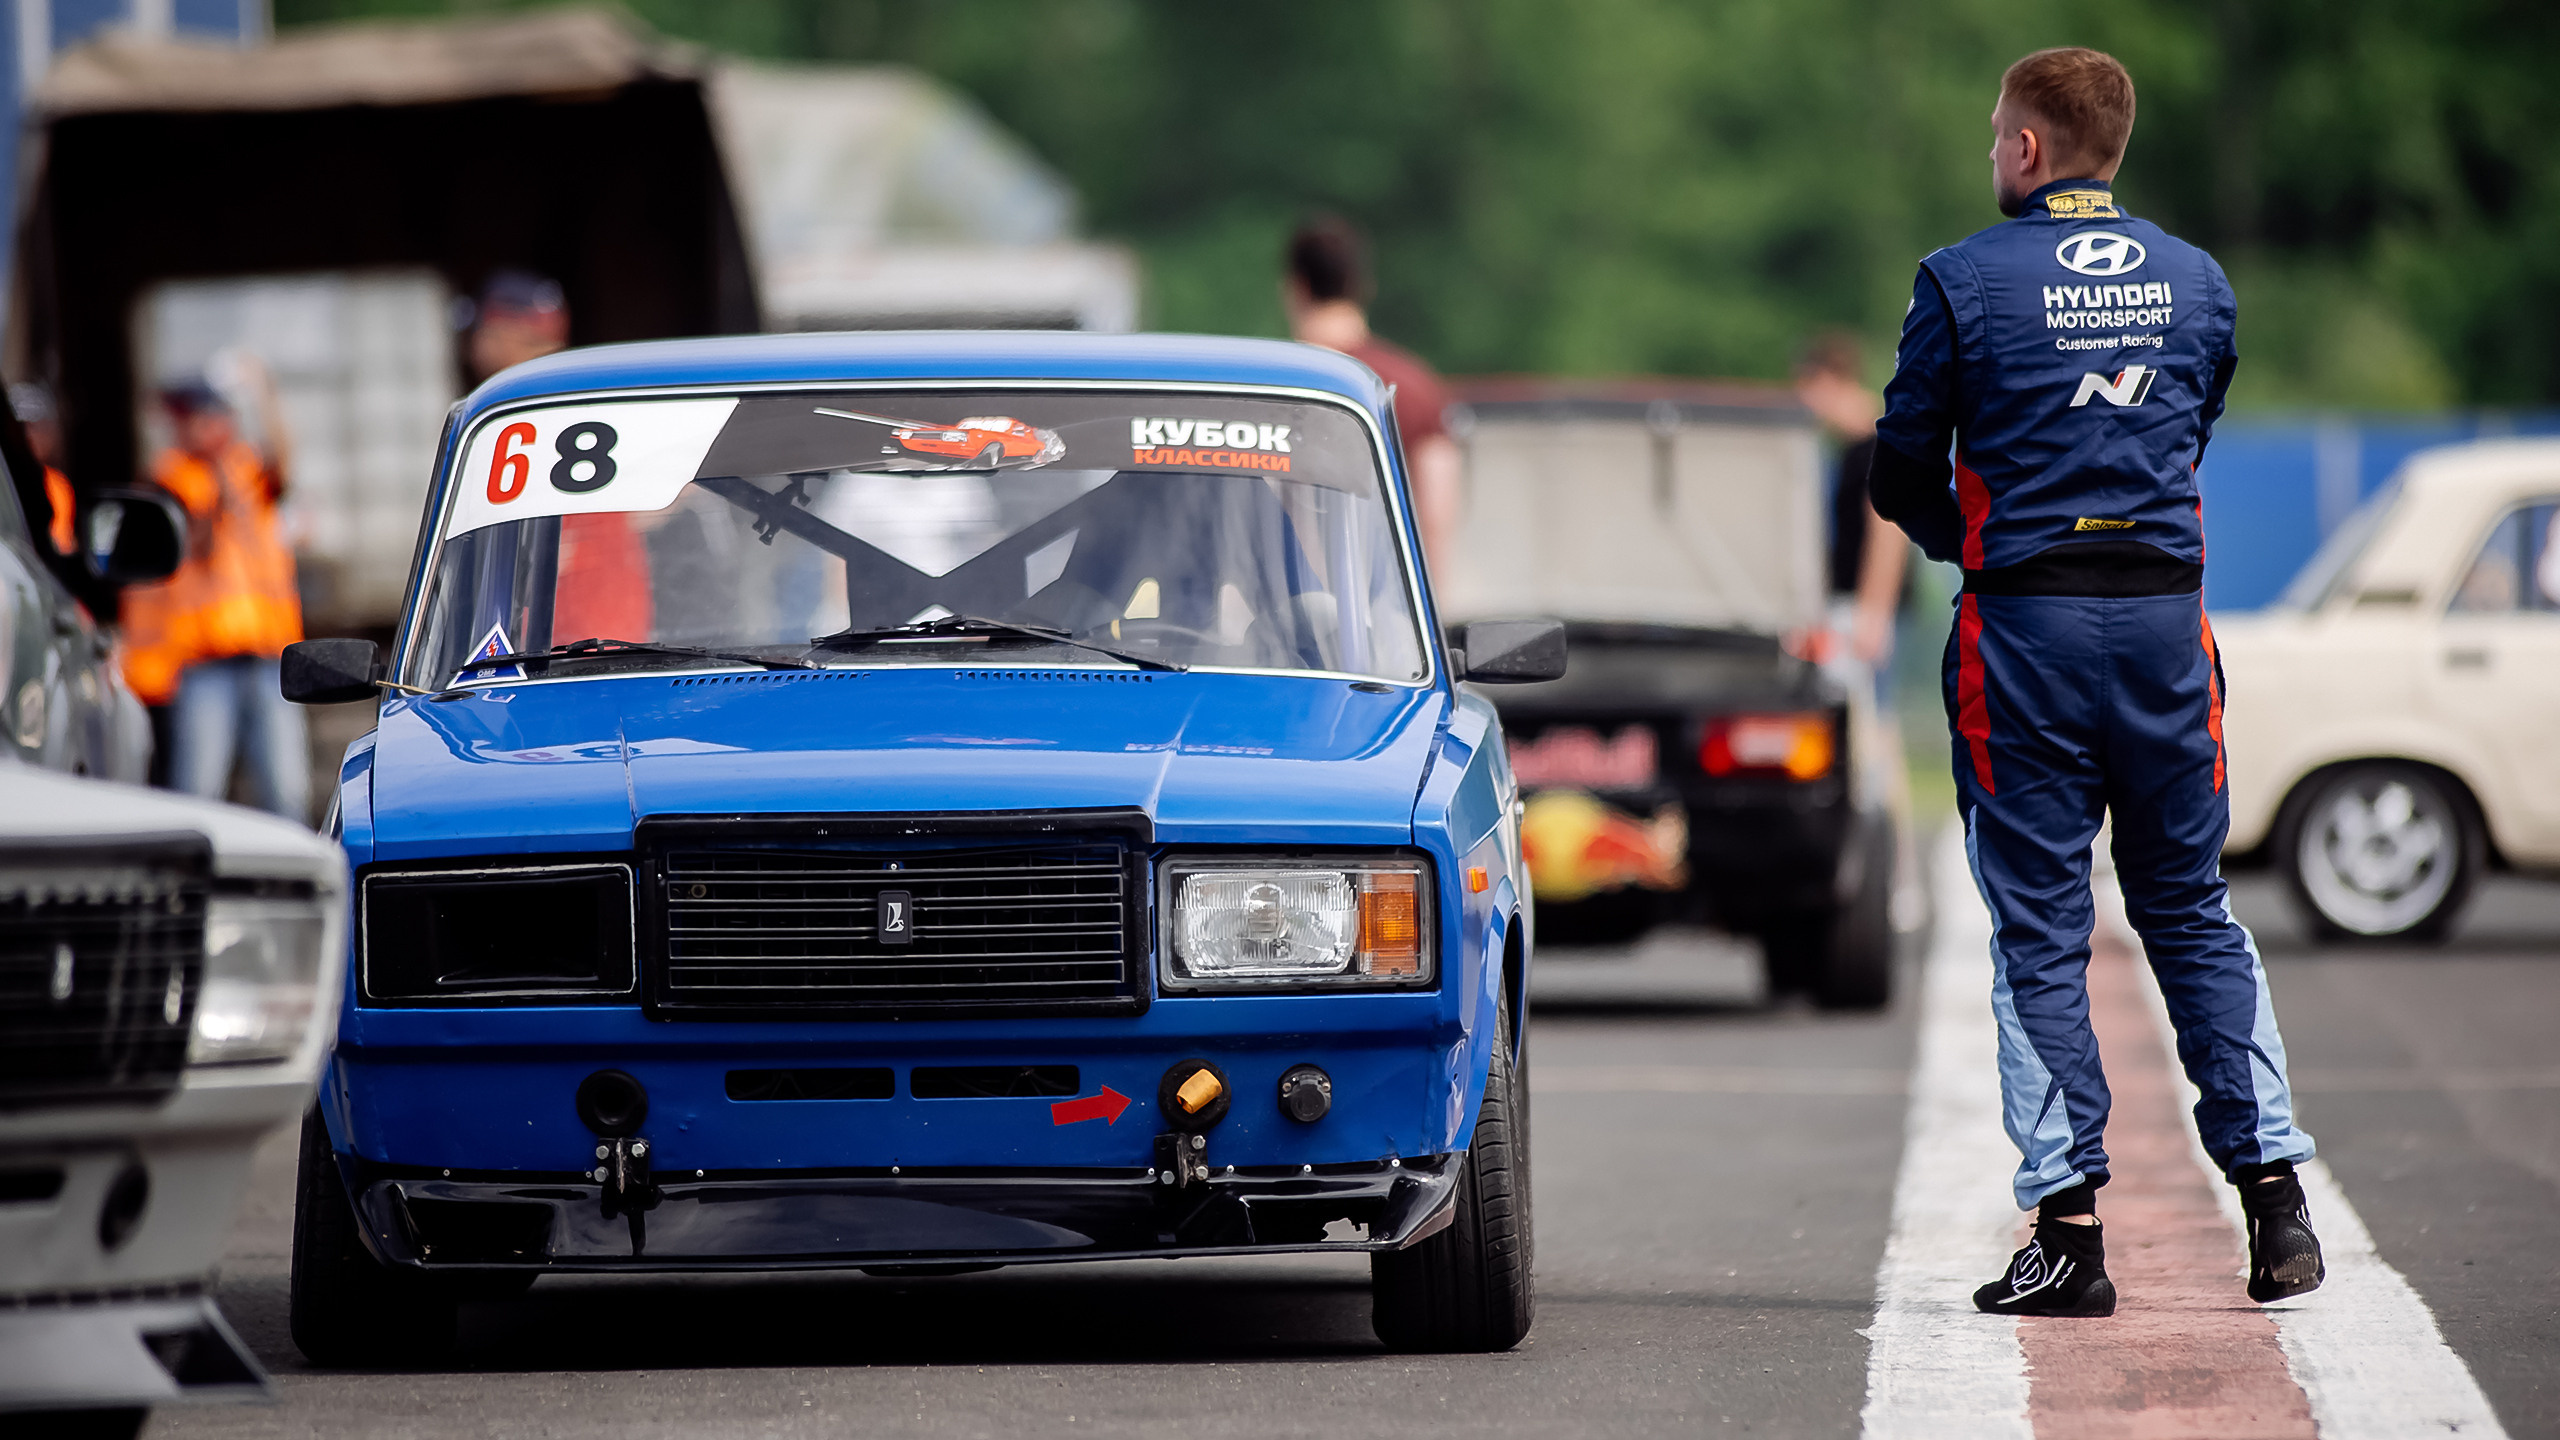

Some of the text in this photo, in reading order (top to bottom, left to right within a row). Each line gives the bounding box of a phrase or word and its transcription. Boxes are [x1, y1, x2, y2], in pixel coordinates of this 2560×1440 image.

[2043, 281, 2173, 309] HYUNDAI
[2046, 306, 2173, 329] MOTORSPORT
[2056, 332, 2163, 350] Customer Racing
[1131, 417, 1292, 452] КУБОК
[1135, 449, 1290, 472] КЛАССИКИ
[477, 668, 496, 678] OMP
